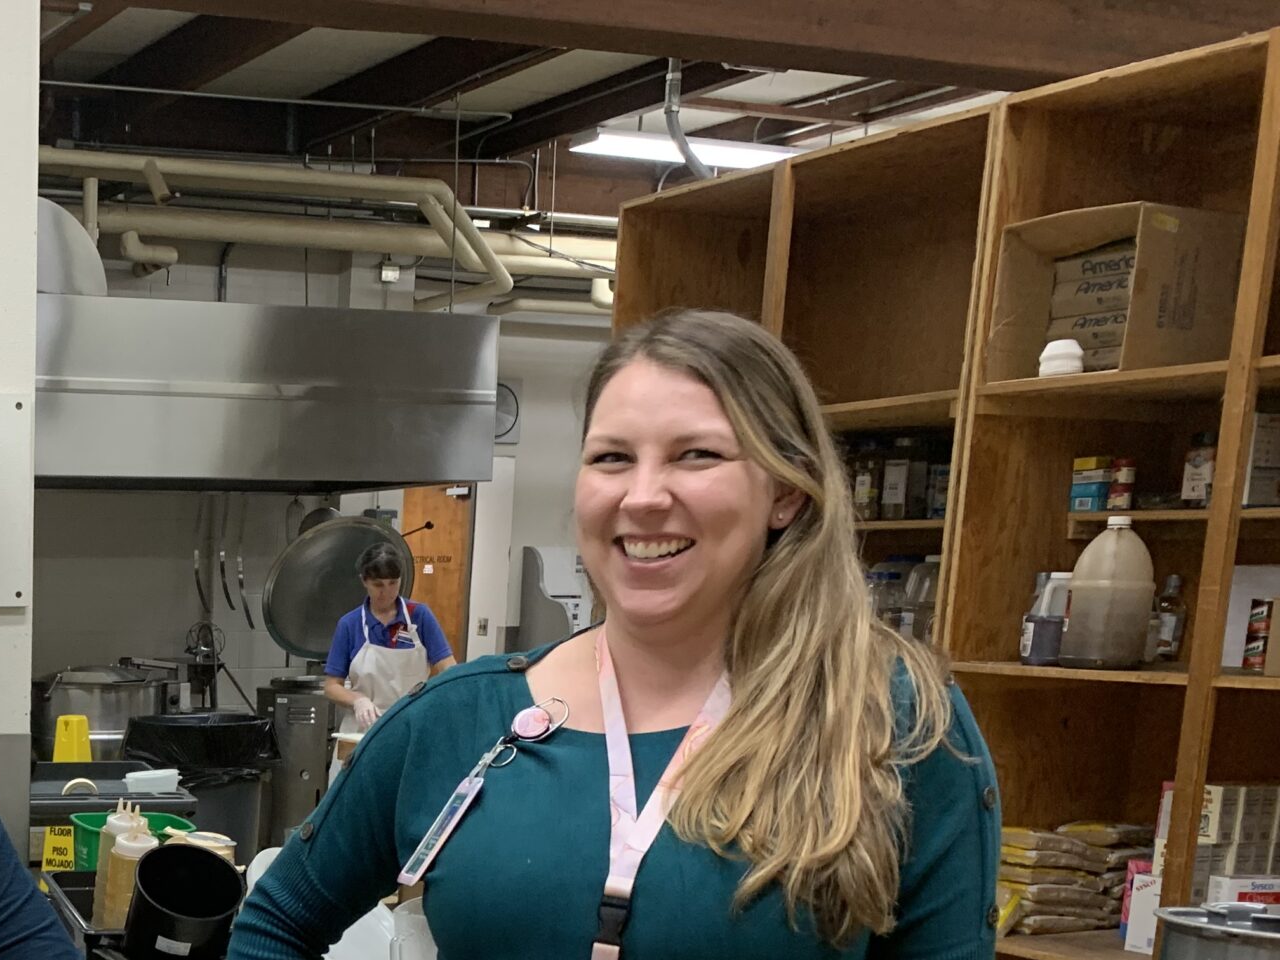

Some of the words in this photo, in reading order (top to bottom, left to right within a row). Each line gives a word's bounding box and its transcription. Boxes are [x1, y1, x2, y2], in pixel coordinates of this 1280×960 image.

[49, 826, 72, 838] FLOOR
[51, 846, 68, 857] PISO
[45, 858, 74, 869] MOJADO
